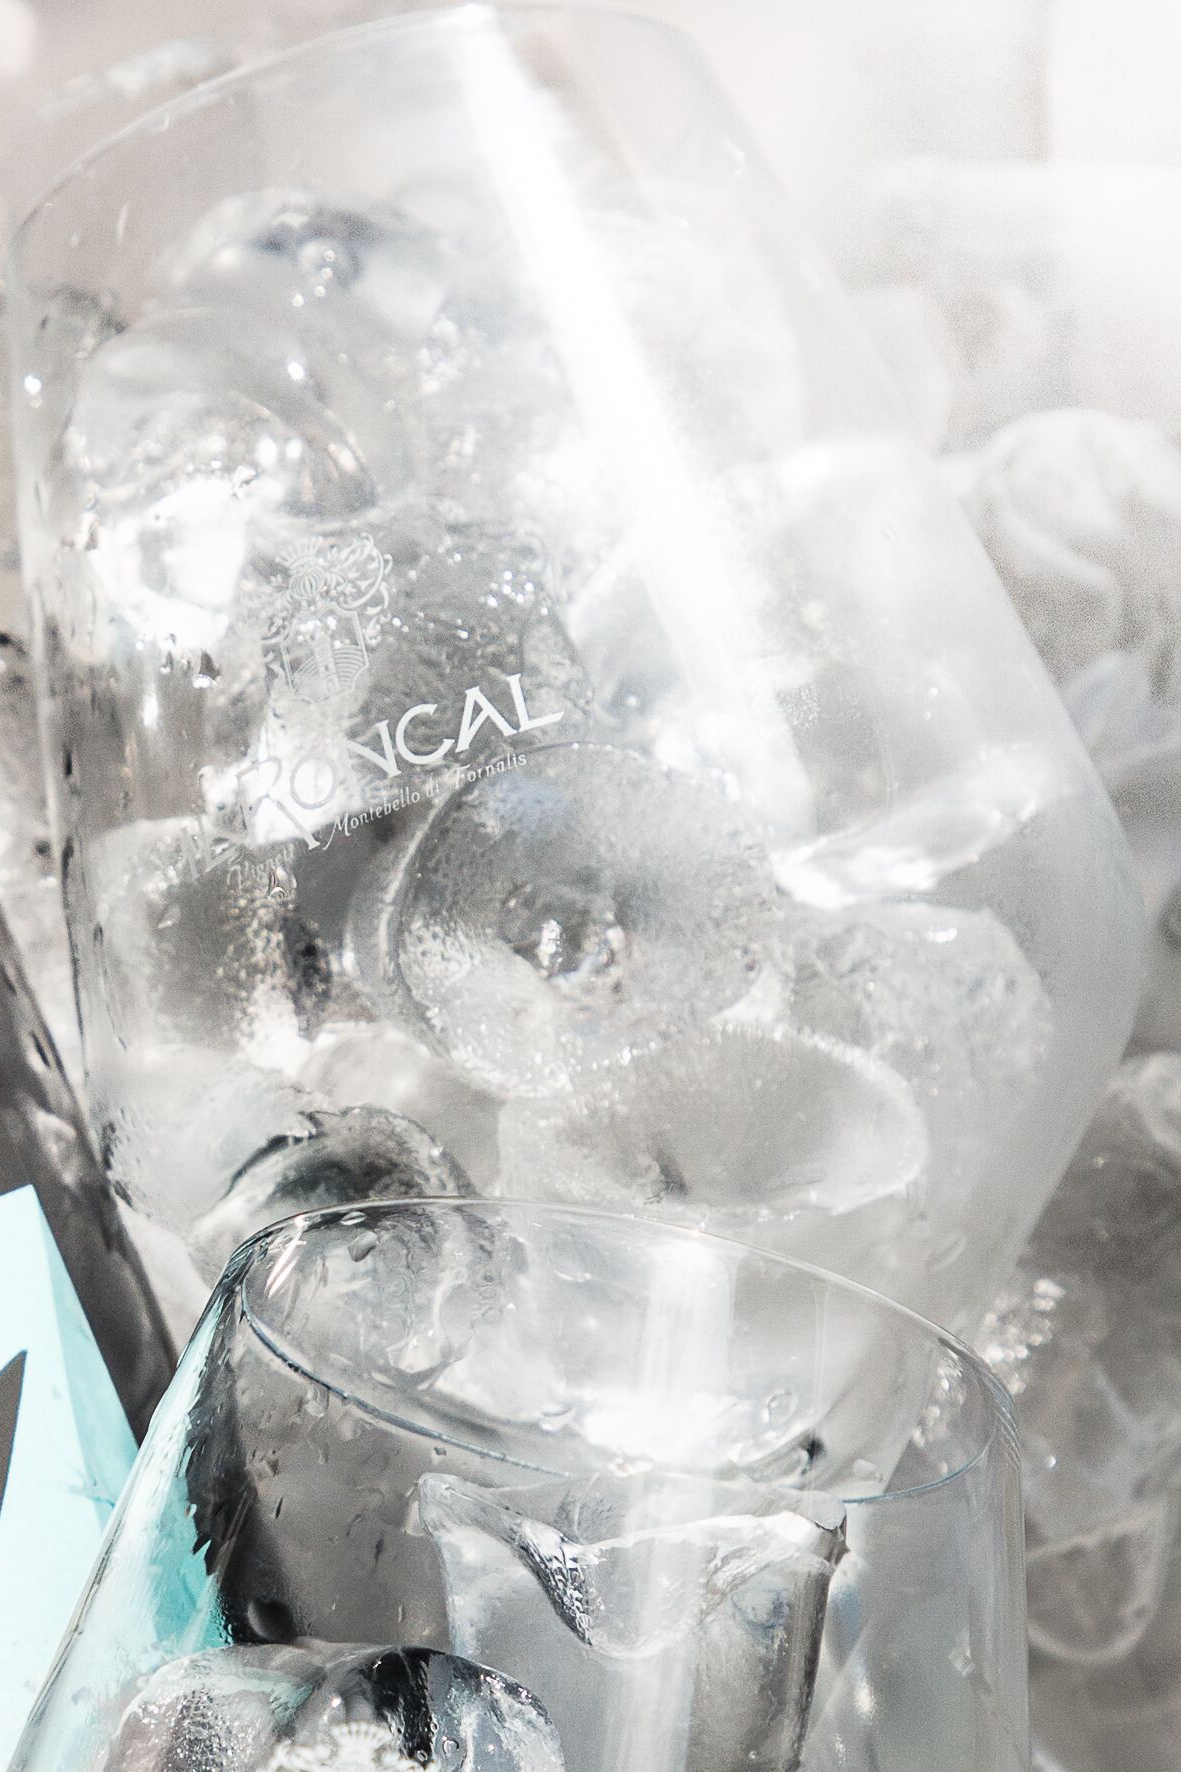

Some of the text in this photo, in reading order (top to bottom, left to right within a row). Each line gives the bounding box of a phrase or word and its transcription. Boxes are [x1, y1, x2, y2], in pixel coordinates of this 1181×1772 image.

[237, 673, 565, 851] RONCAL
[322, 785, 421, 850] Montebello
[425, 776, 441, 798] di
[449, 753, 528, 791] Fornalis
